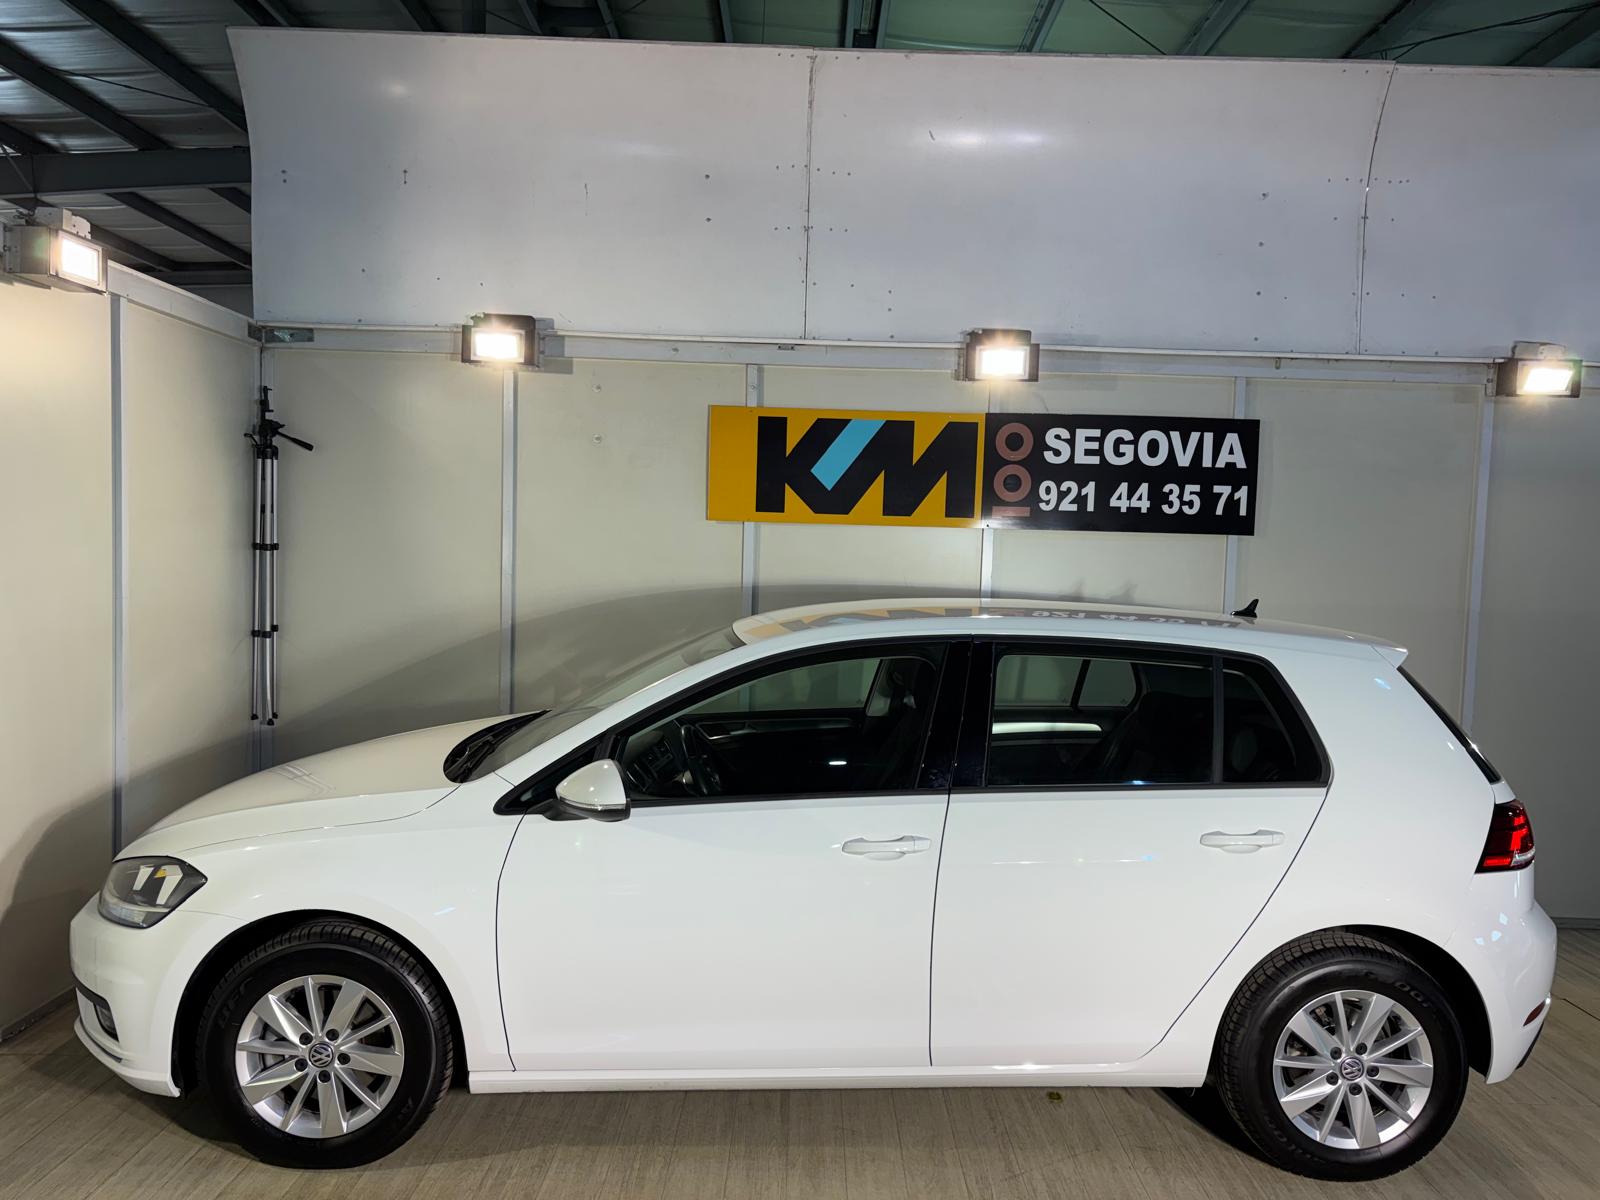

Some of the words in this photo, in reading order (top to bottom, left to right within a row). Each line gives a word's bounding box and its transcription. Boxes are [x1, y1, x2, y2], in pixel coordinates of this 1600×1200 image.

[756, 416, 979, 518] KM
[1043, 427, 1247, 469] SEGOVIA
[1038, 480, 1096, 512] 921
[1109, 481, 1151, 513] 44
[1161, 483, 1201, 515] 35
[1212, 485, 1249, 516] 71
